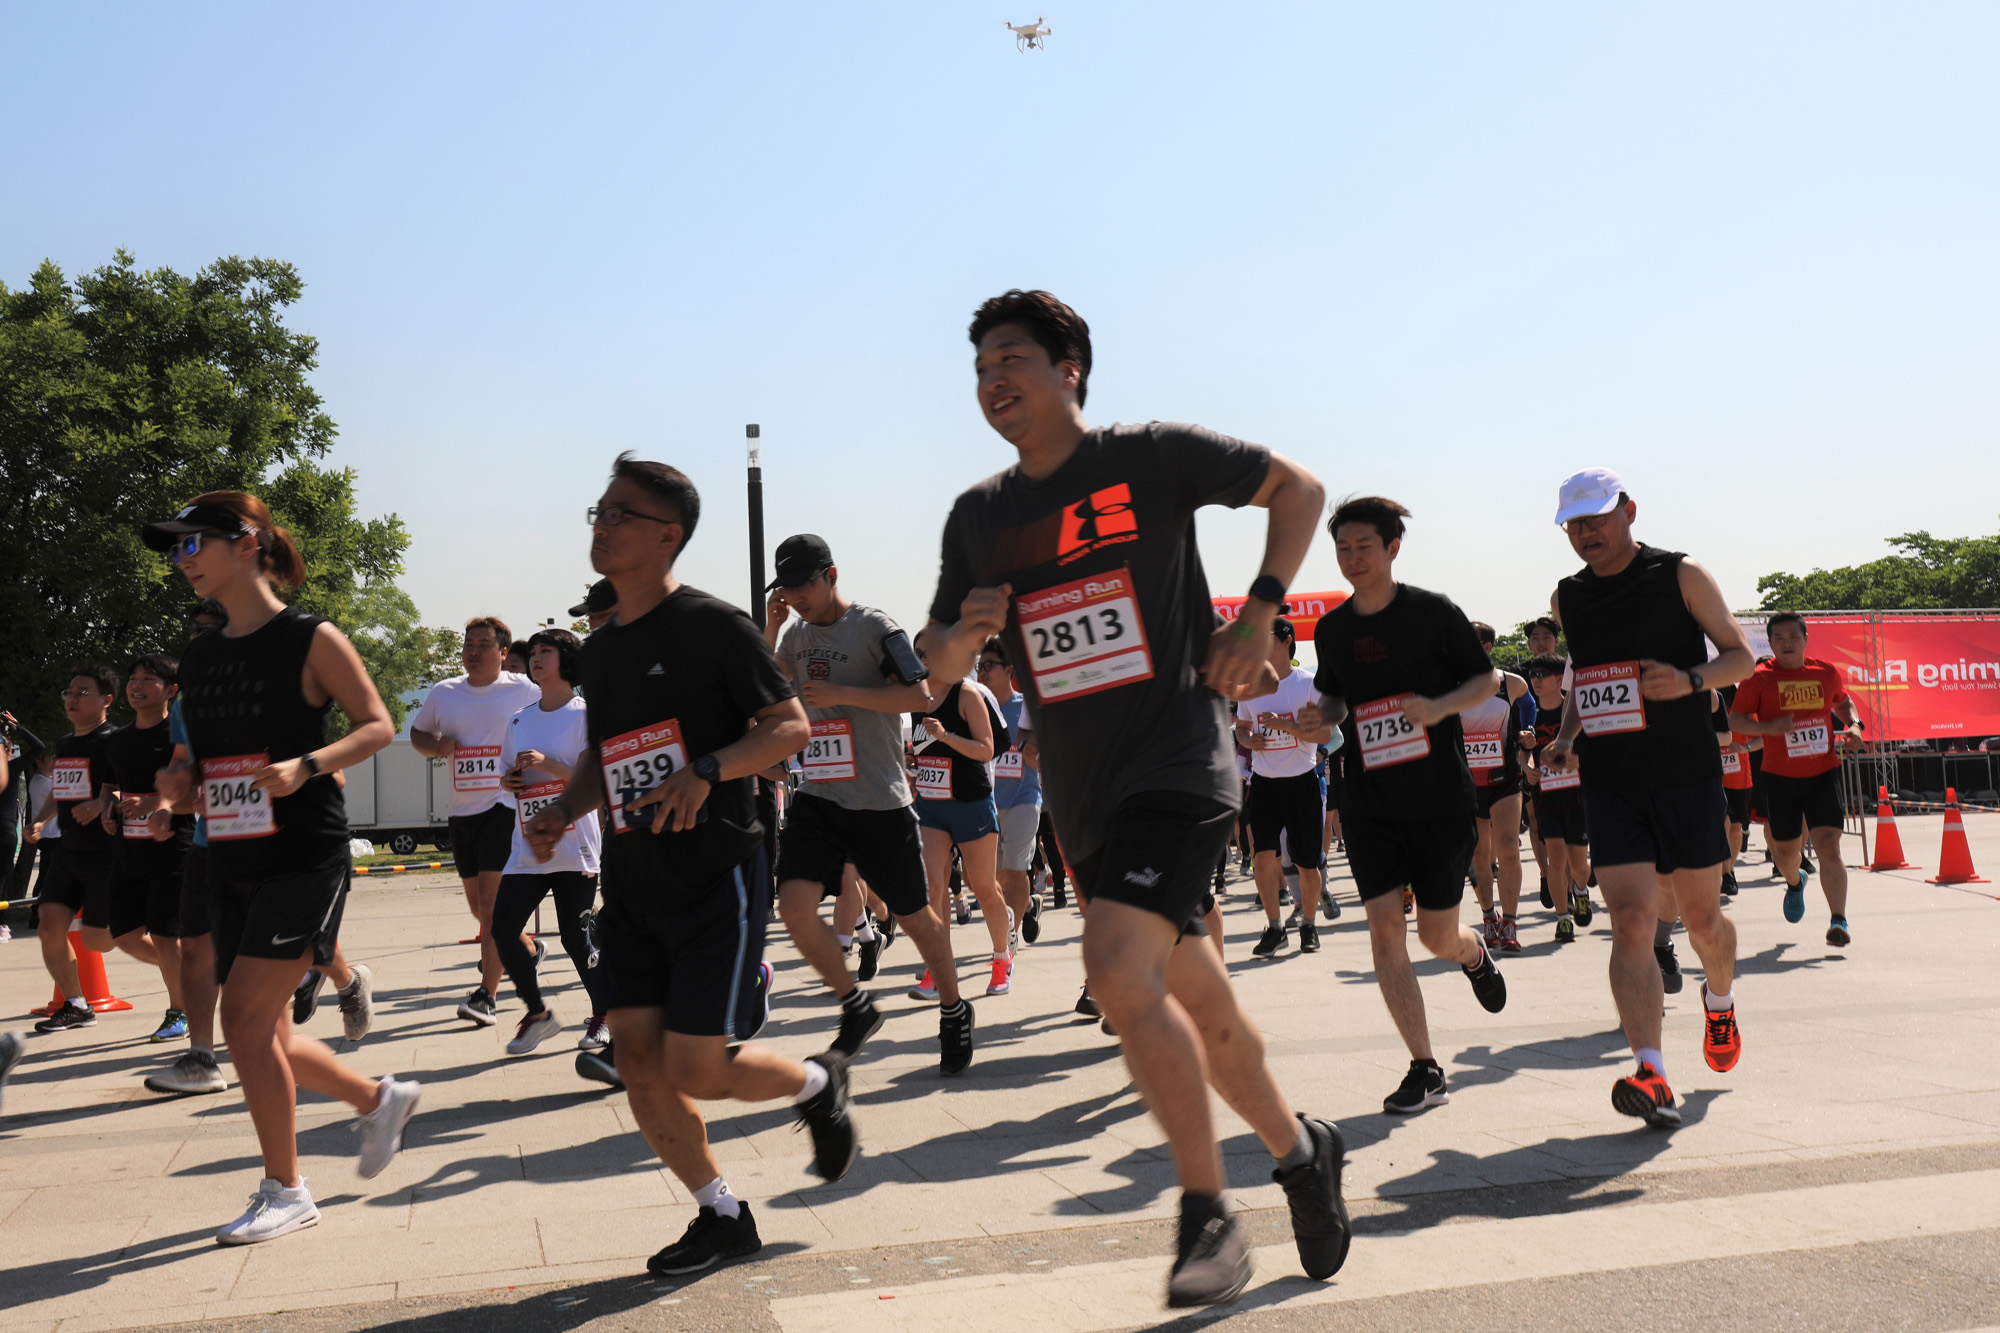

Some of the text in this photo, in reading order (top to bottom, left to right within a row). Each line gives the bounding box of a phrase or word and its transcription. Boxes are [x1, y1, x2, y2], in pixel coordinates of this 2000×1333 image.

[1018, 589, 1083, 615] Burning
[1084, 578, 1123, 597] Run
[1031, 608, 1124, 659] 2813
[1576, 666, 1633, 681] Burning Run
[1580, 684, 1631, 710] 2042
[1785, 685, 1819, 704] 2009
[1356, 703, 1388, 717] Burning
[640, 728, 672, 744] Run
[1363, 715, 1414, 743] 2738
[1790, 728, 1824, 743] 3187
[807, 739, 842, 758] 2811
[1465, 743, 1497, 755] 2474
[457, 759, 495, 774] 2814
[610, 753, 675, 795] 2439
[56, 771, 82, 783] 3107
[919, 769, 945, 783] 3037
[209, 780, 262, 808] 3046
[547, 783, 564, 791] Run
